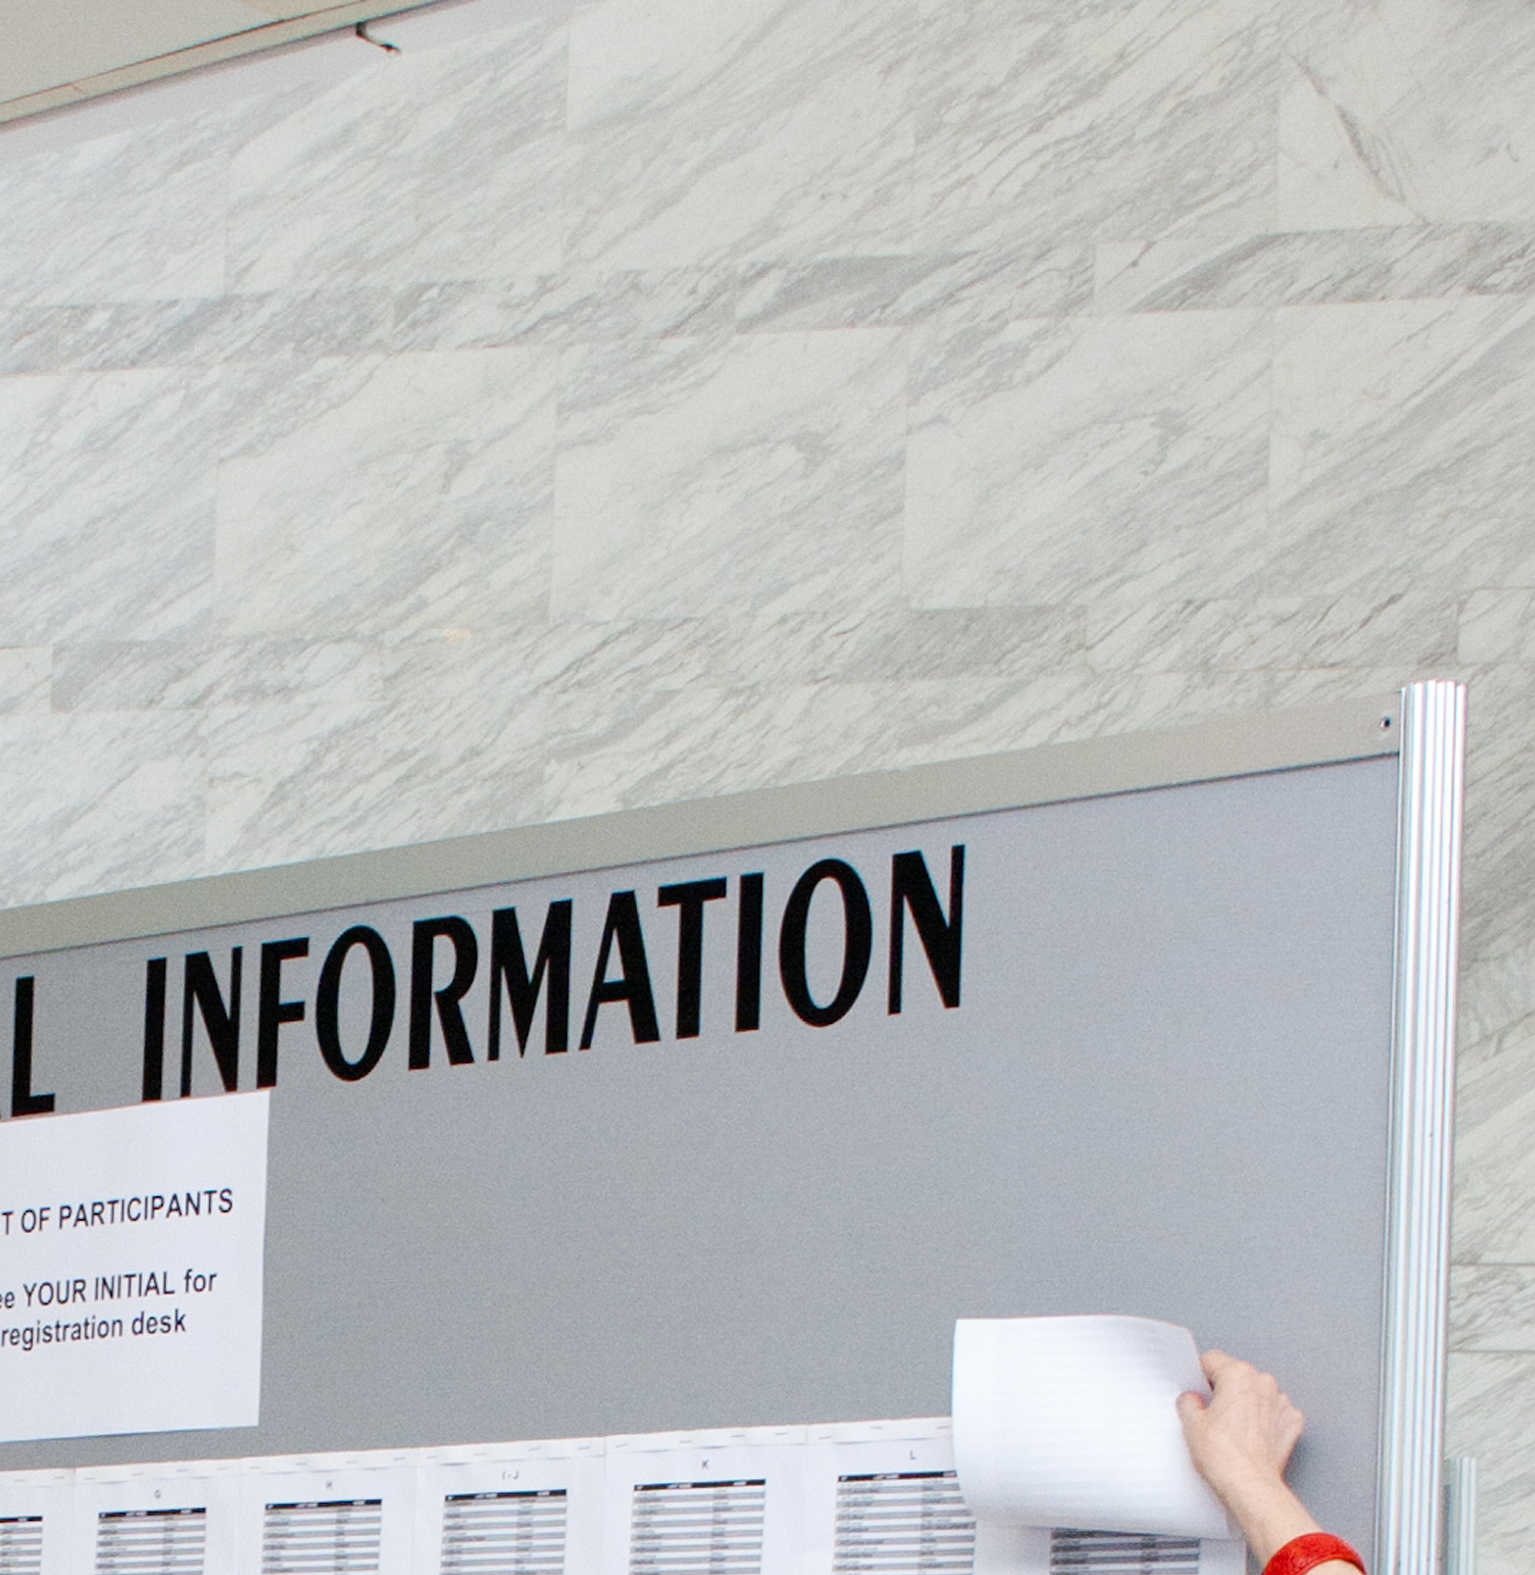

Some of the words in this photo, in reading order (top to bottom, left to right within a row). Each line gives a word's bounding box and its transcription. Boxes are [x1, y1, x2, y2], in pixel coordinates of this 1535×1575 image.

[142, 844, 965, 1102] INFORMATION
[20, 1206, 51, 1234] OF
[58, 1187, 234, 1230] PARTICIPANTS
[23, 1278, 87, 1308] YOUR
[94, 1270, 177, 1301] INITIAL
[183, 1267, 218, 1294] for
[0, 1313, 124, 1353] registration
[130, 1307, 187, 1337] desk
